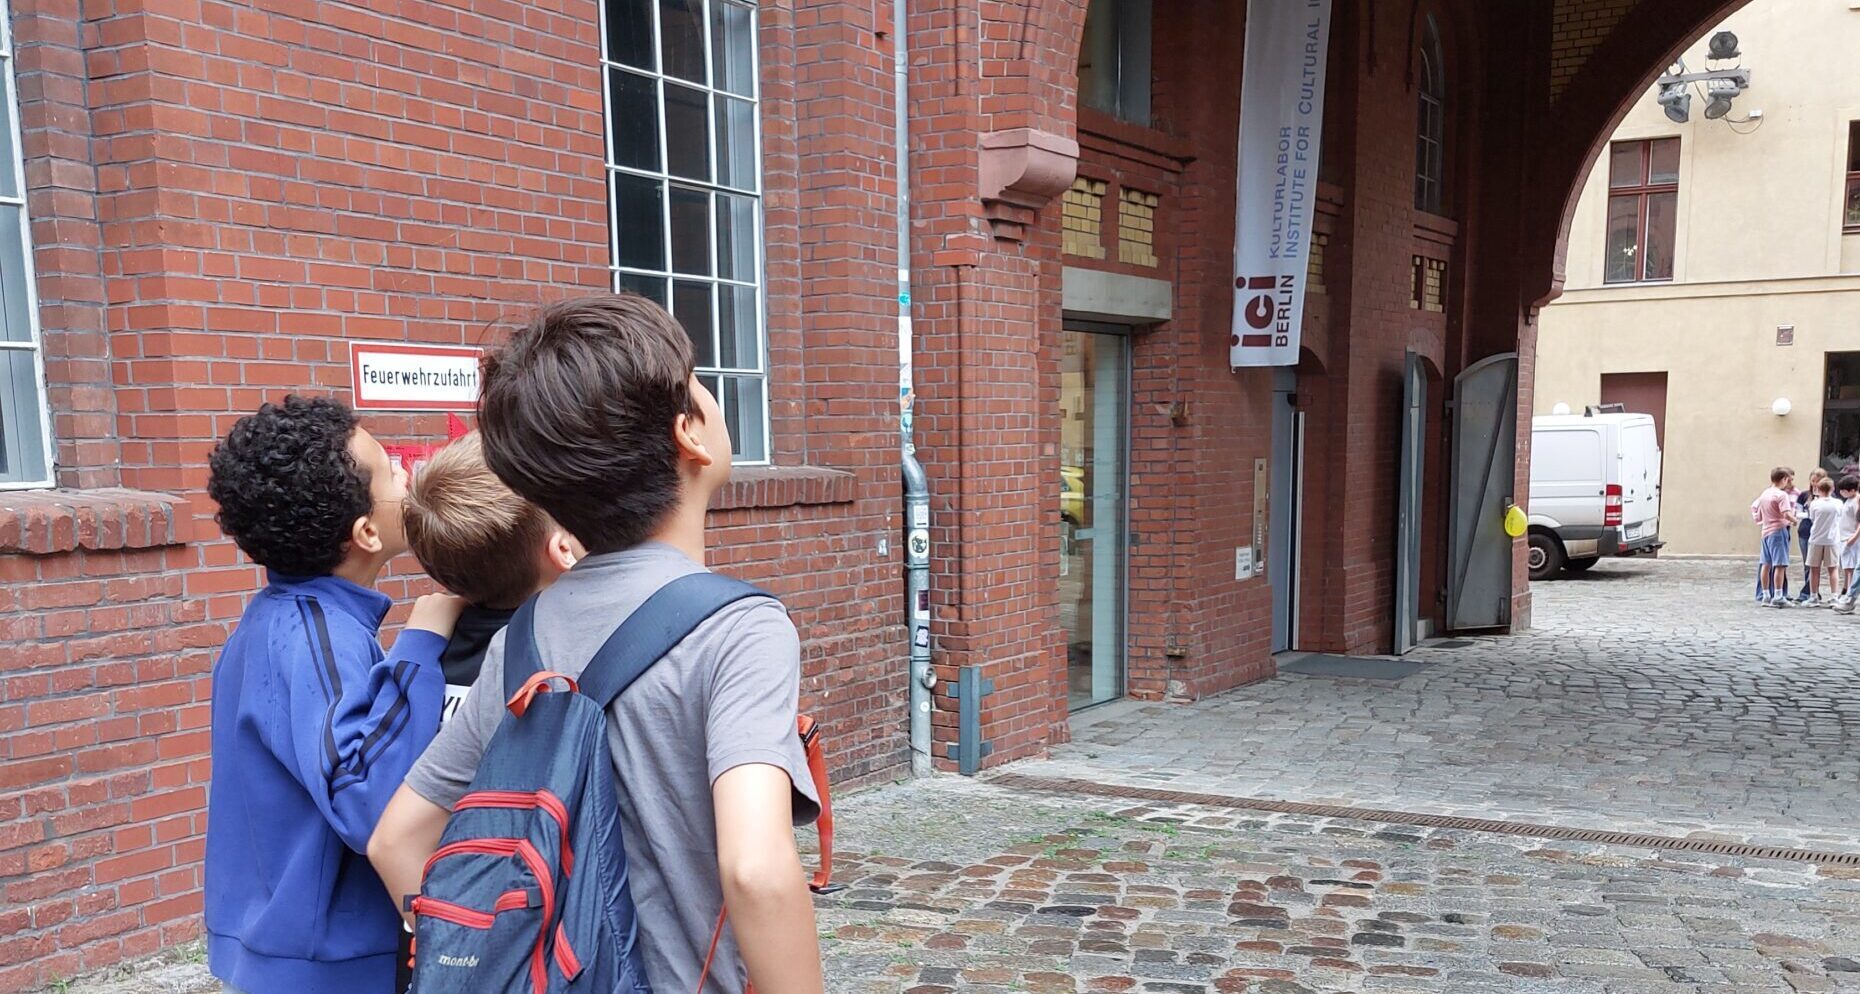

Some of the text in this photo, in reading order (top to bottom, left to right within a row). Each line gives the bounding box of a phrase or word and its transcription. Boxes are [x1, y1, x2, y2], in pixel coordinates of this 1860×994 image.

[1298, 17, 1321, 115] CULTURAL
[1295, 126, 1310, 161] FOR
[1269, 126, 1291, 259] KULTURLABOR
[1283, 168, 1306, 258] INSTITUTE
[1231, 275, 1277, 347] ici
[1275, 275, 1295, 347] BERLIN
